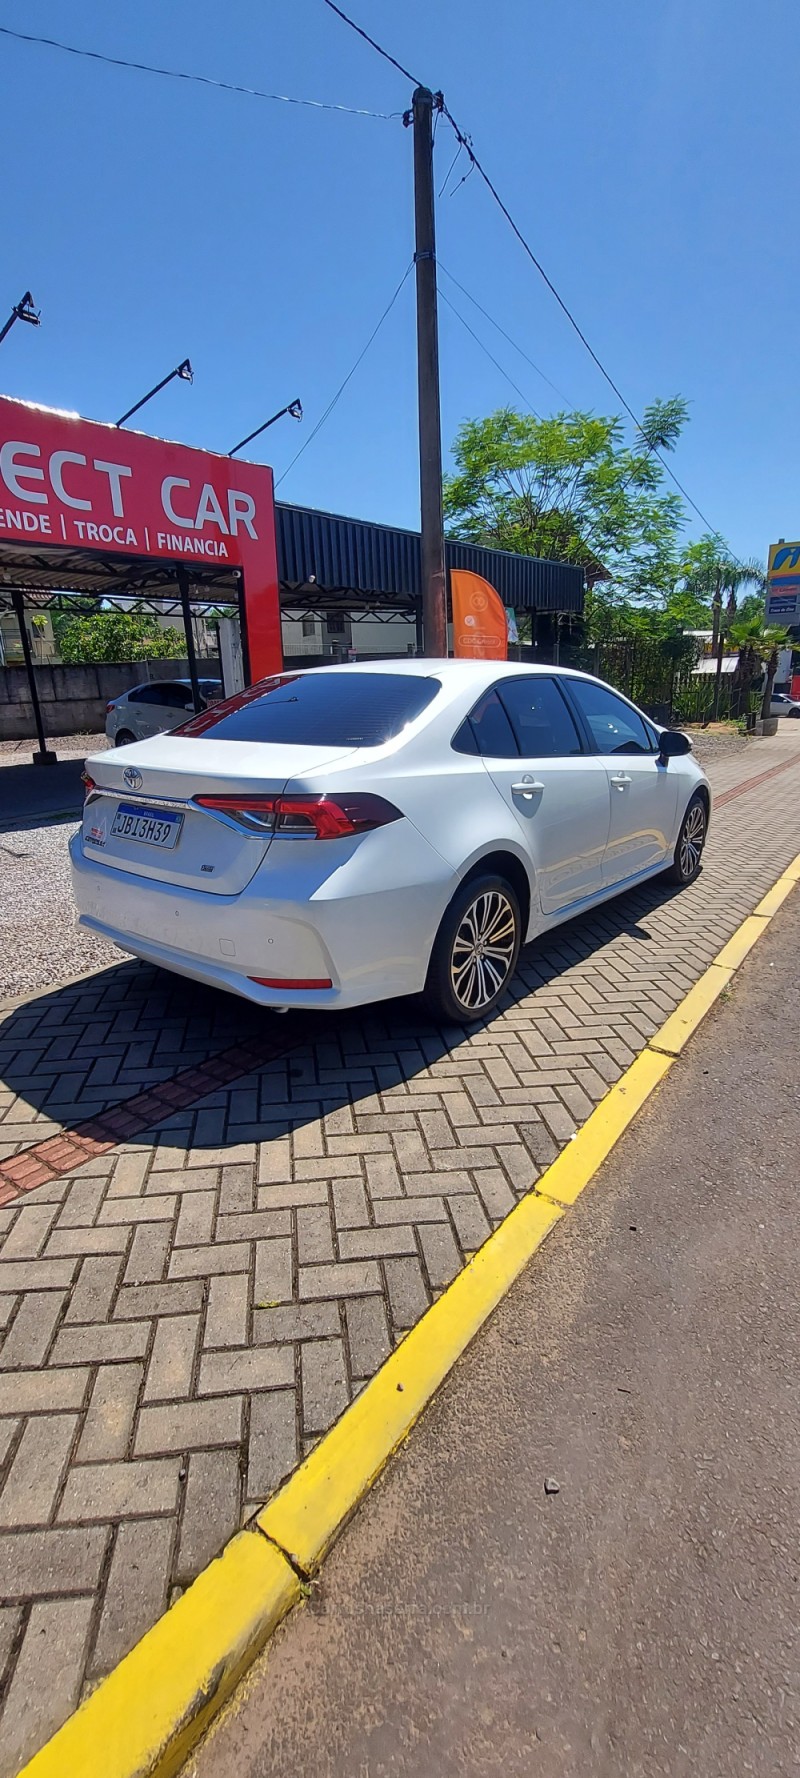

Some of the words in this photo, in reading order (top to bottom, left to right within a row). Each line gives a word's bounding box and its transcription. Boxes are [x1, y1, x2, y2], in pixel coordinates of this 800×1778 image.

[161, 476, 258, 540] CAR
[74, 520, 138, 546] TROCA
[157, 533, 229, 558] FINANCIA
[117, 815, 172, 842] JBI3H39
